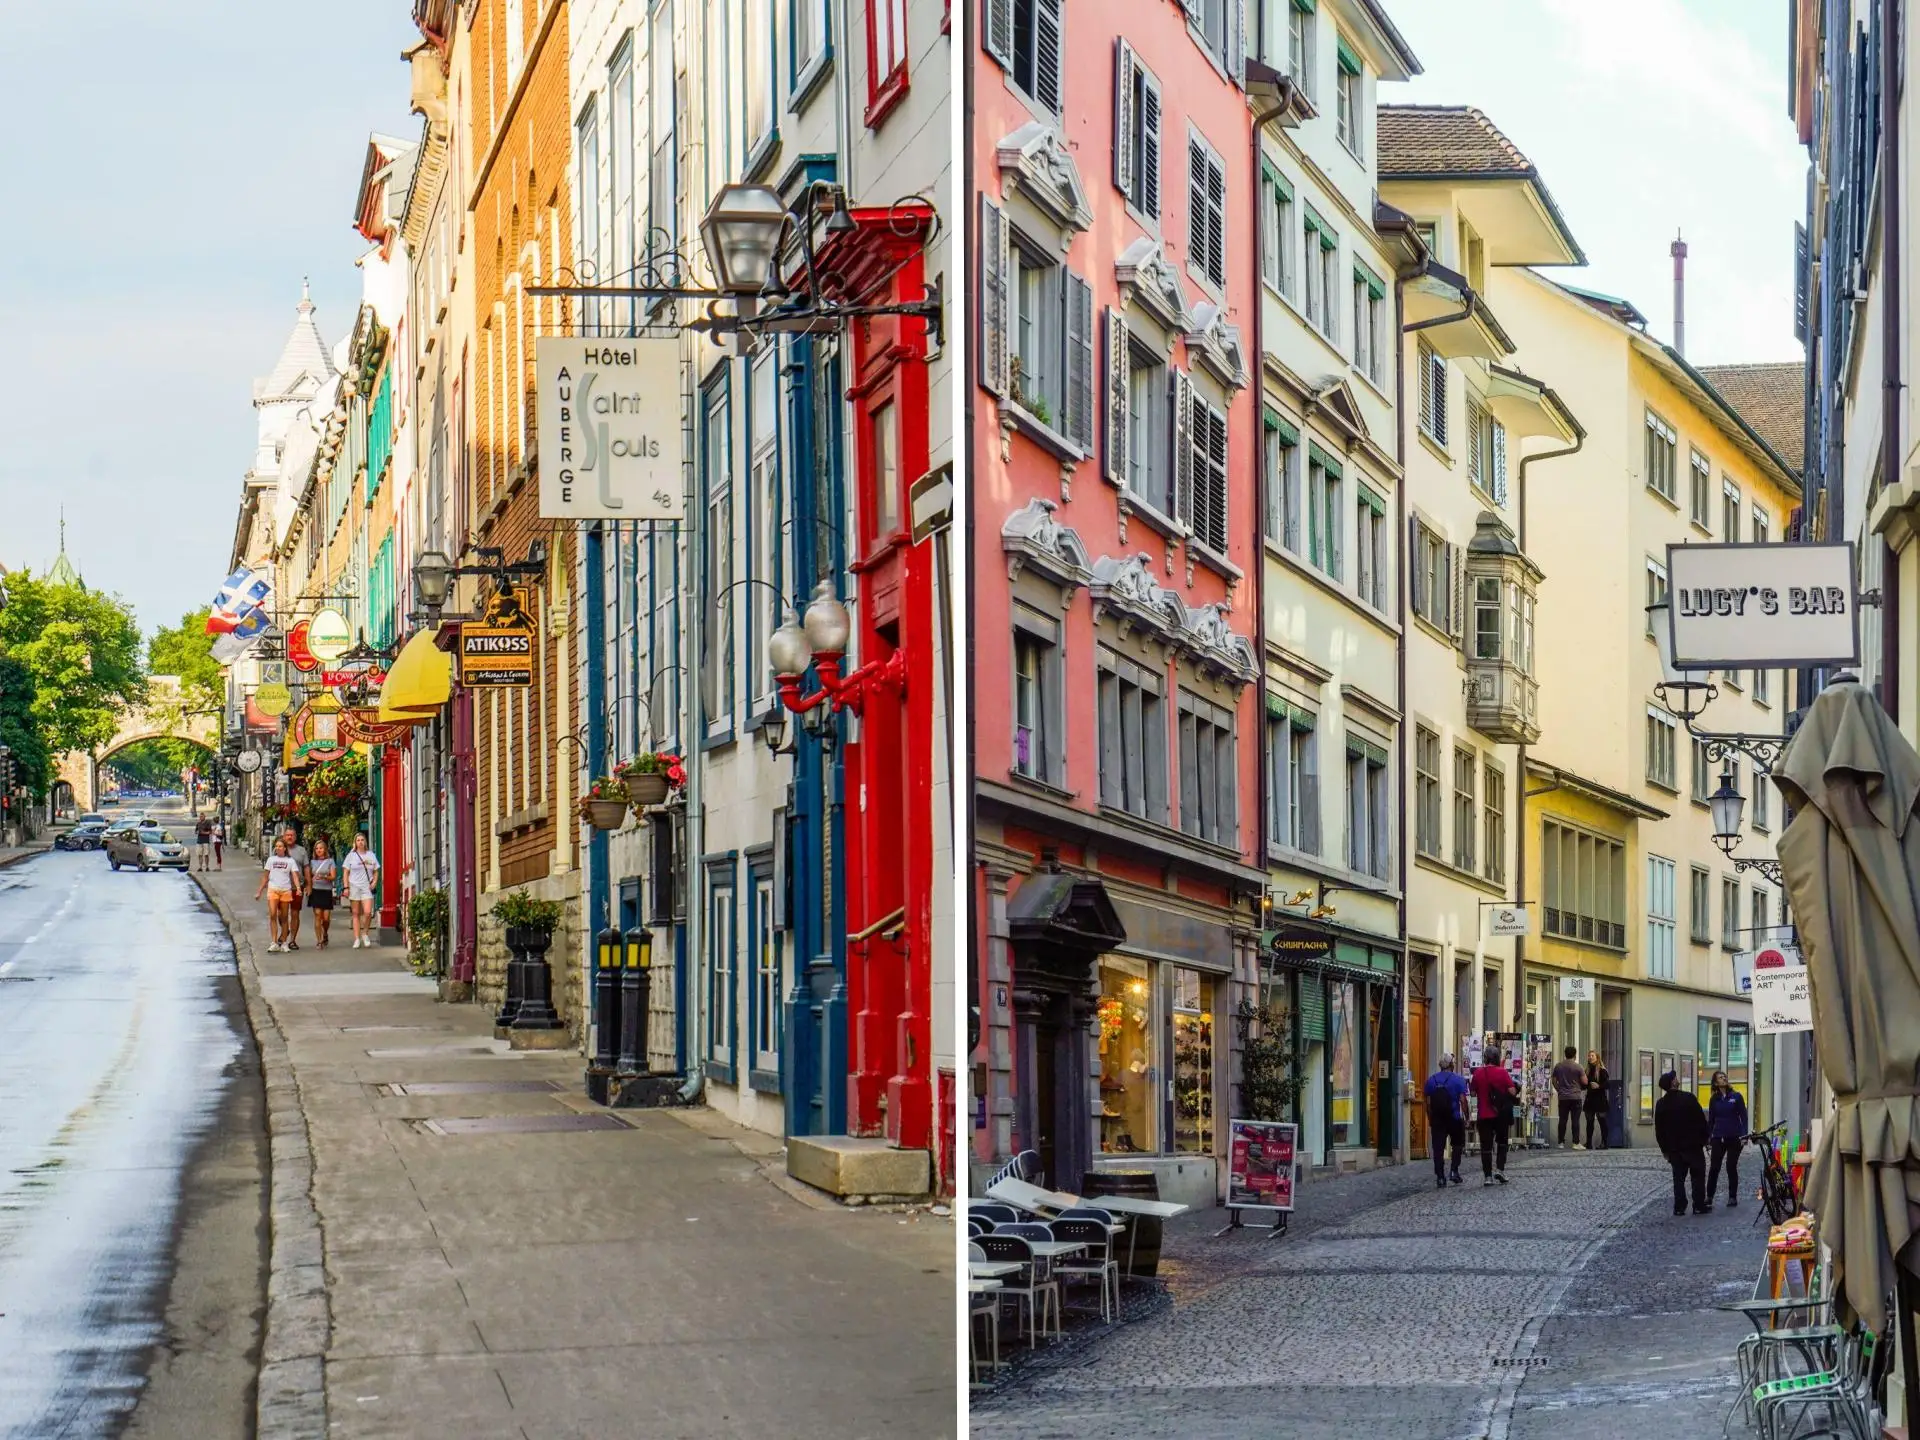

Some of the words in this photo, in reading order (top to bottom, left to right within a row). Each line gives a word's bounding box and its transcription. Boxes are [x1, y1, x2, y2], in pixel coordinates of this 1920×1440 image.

[584, 347, 638, 366] Hôtel
[557, 366, 574, 503] AUBERGE
[575, 372, 642, 472] Saint
[597, 421, 660, 510] Louis
[651, 488, 672, 510] 48
[1678, 586, 1779, 617] LUCY'S
[1787, 586, 1845, 615] BAR
[1274, 940, 1329, 949] SCHUHMACHER
[1757, 981, 1773, 989] ART
